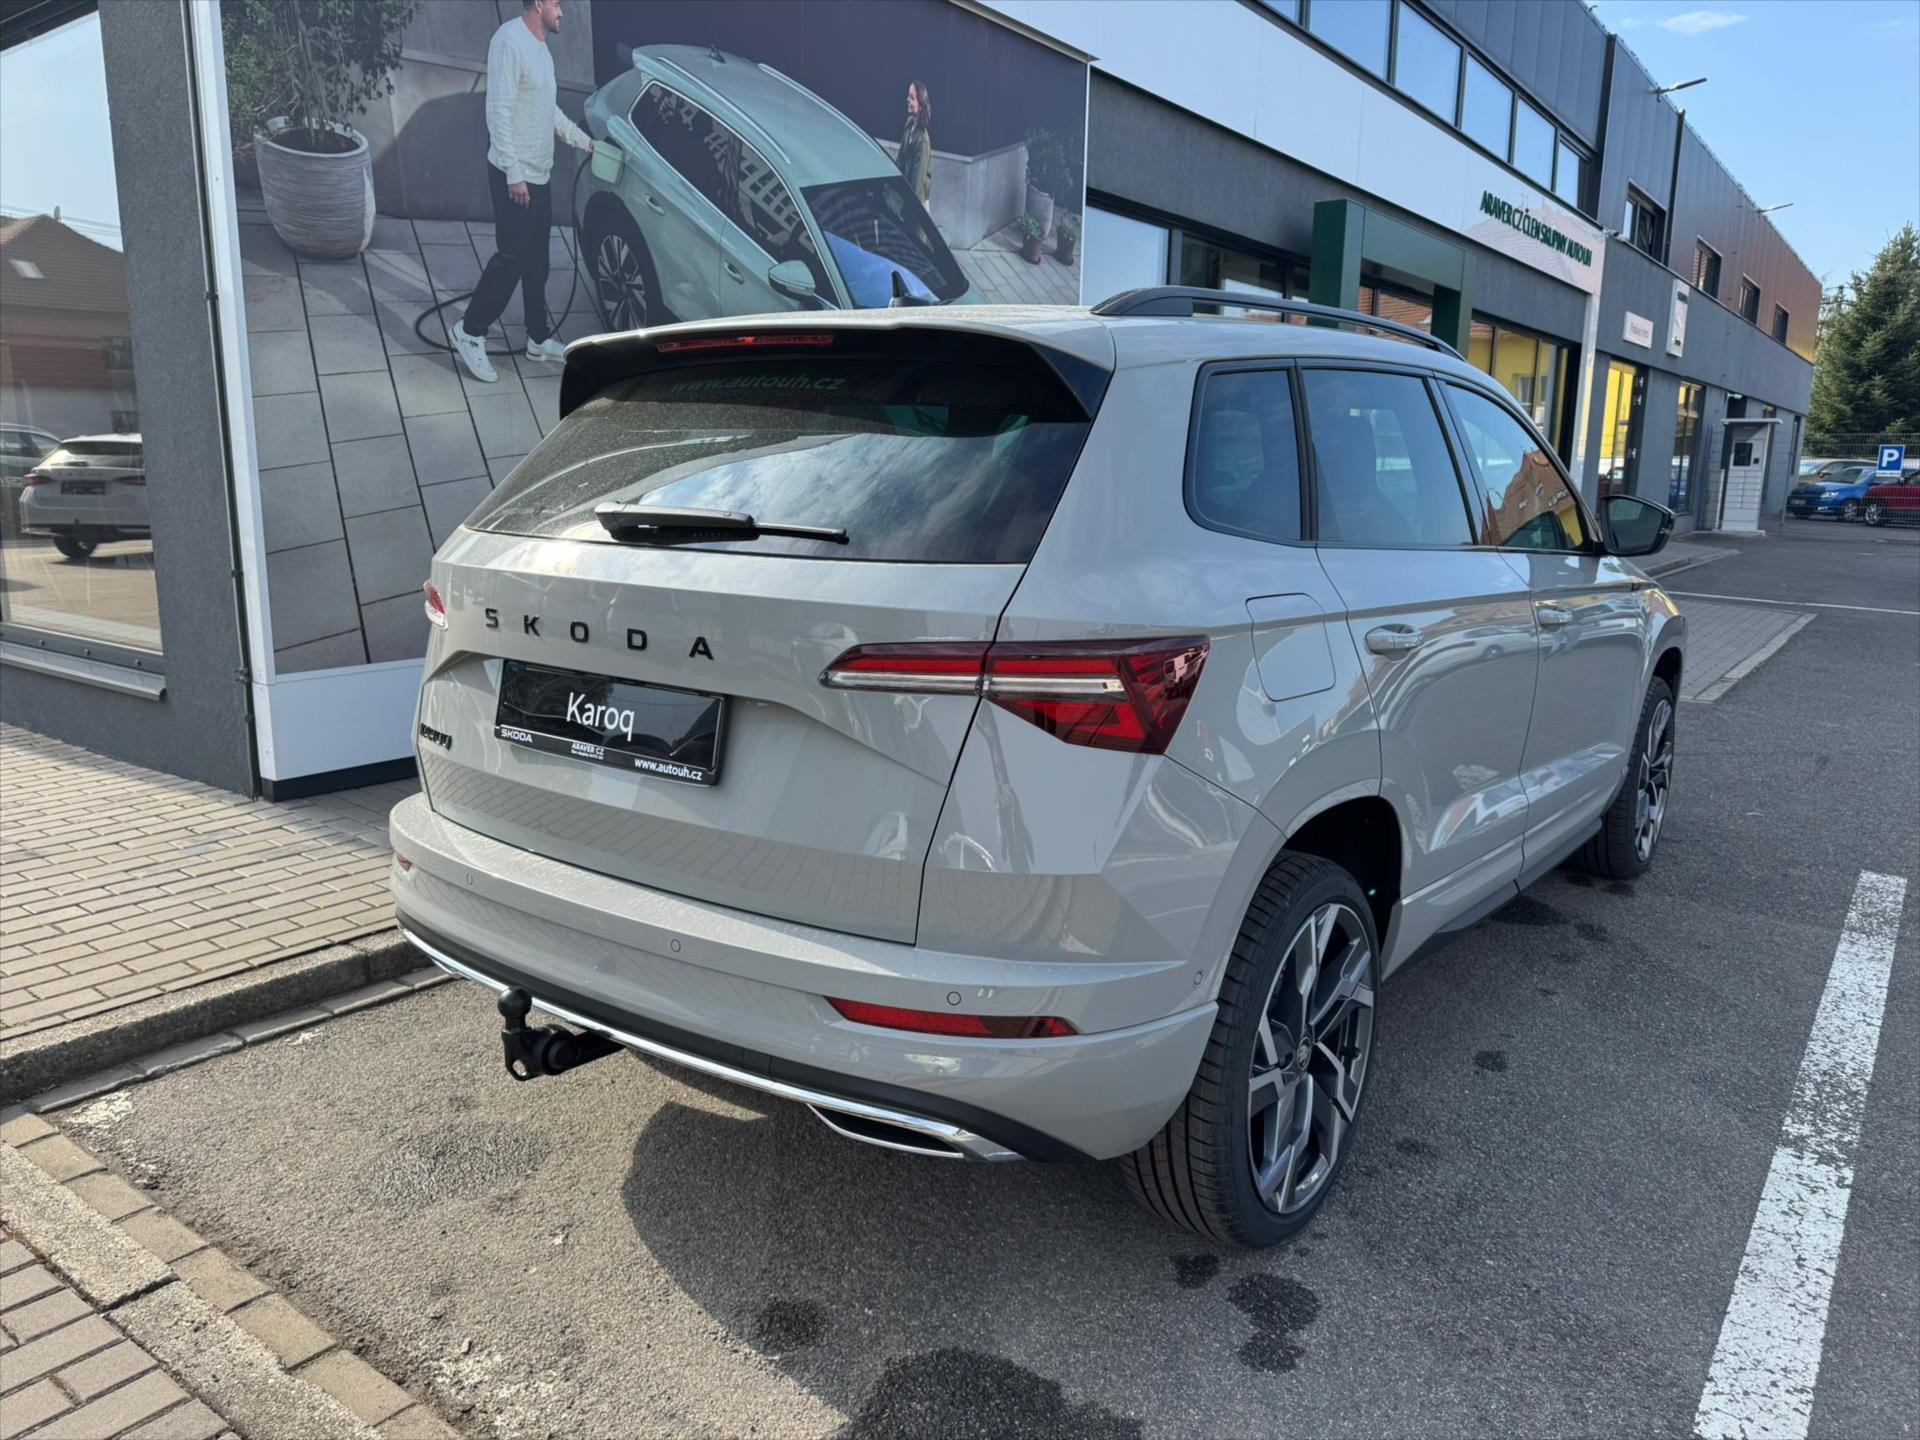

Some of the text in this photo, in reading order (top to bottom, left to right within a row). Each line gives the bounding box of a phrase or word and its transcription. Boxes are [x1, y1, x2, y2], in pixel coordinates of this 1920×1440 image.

[1480, 189, 1513, 226] ARAVER
[1512, 208, 1524, 231] CZ
[671, 374, 847, 391] www.autouh.cz
[1881, 448, 1900, 468] P
[566, 692, 635, 742] Karoq
[634, 758, 703, 781] www.autouh.cz
